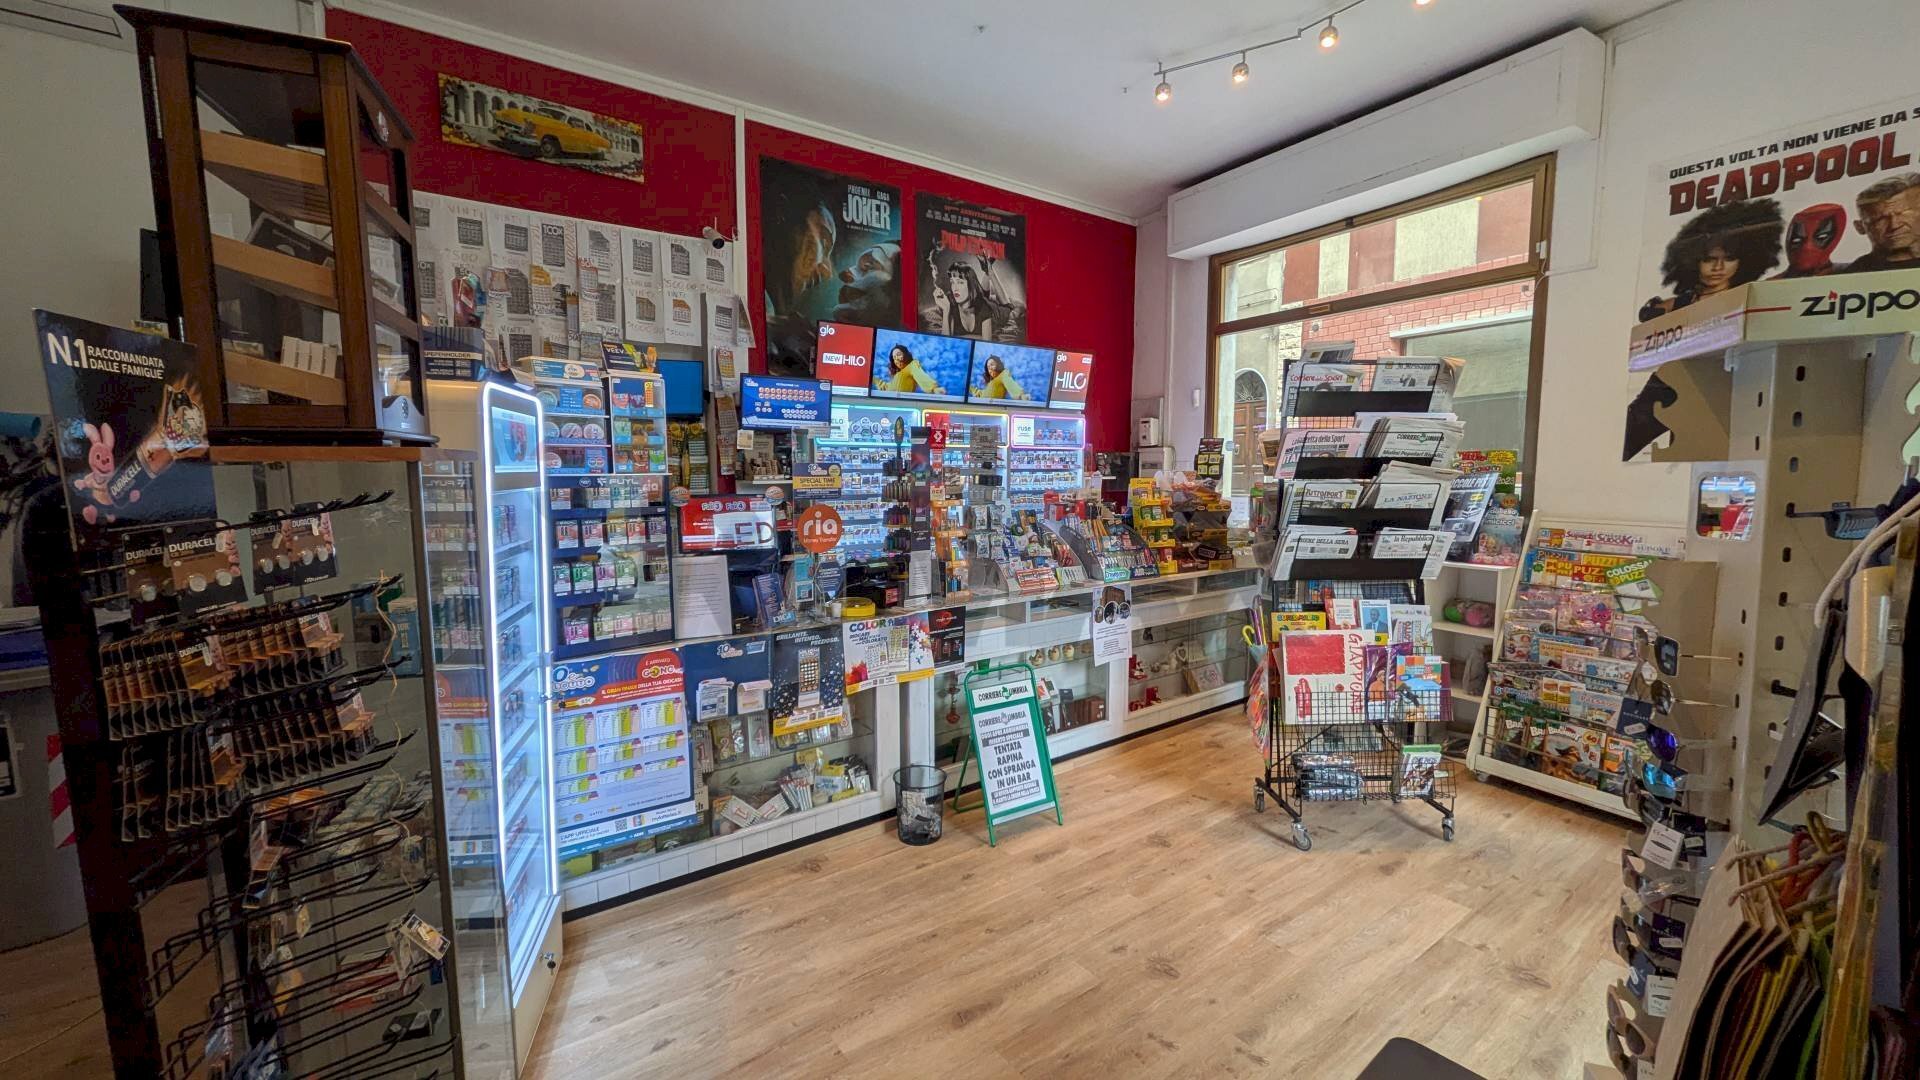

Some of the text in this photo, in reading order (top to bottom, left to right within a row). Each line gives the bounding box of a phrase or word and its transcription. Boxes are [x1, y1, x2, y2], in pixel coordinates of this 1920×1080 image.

[1669, 157, 1724, 180] QUESTA
[1729, 143, 1778, 164] VOLTA
[1783, 133, 1818, 151] NON
[1822, 118, 1876, 142] VIENE
[1880, 110, 1907, 128] DA
[1669, 131, 1911, 217] DEADPOOL
[842, 193, 891, 231] JOKER
[1800, 289, 1920, 320] zippo
[819, 325, 835, 337] glo
[1644, 324, 1684, 352] zippo
[47, 332, 88, 369] N.1
[88, 345, 164, 370] RACCOMANDATA
[1056, 352, 1068, 363] glo
[90, 358, 164, 380] DALLE FAMIGLIE
[825, 354, 866, 367] NEW HILO
[1054, 371, 1087, 389] HILO
[110, 462, 142, 497] DURACELL
[803, 511, 838, 536] ria
[125, 545, 163, 561] DURACEL
[168, 537, 216, 553] DURACEL
[849, 619, 887, 633] COLOR
[641, 665, 676, 678] GONG
[1009, 685, 1028, 696] UMBRIA
[994, 741, 1022, 755] TENTATA
[997, 752, 1024, 766] RAPINA
[988, 759, 1036, 780] CON SPRANGA
[997, 771, 1031, 789] IN UN BAR
